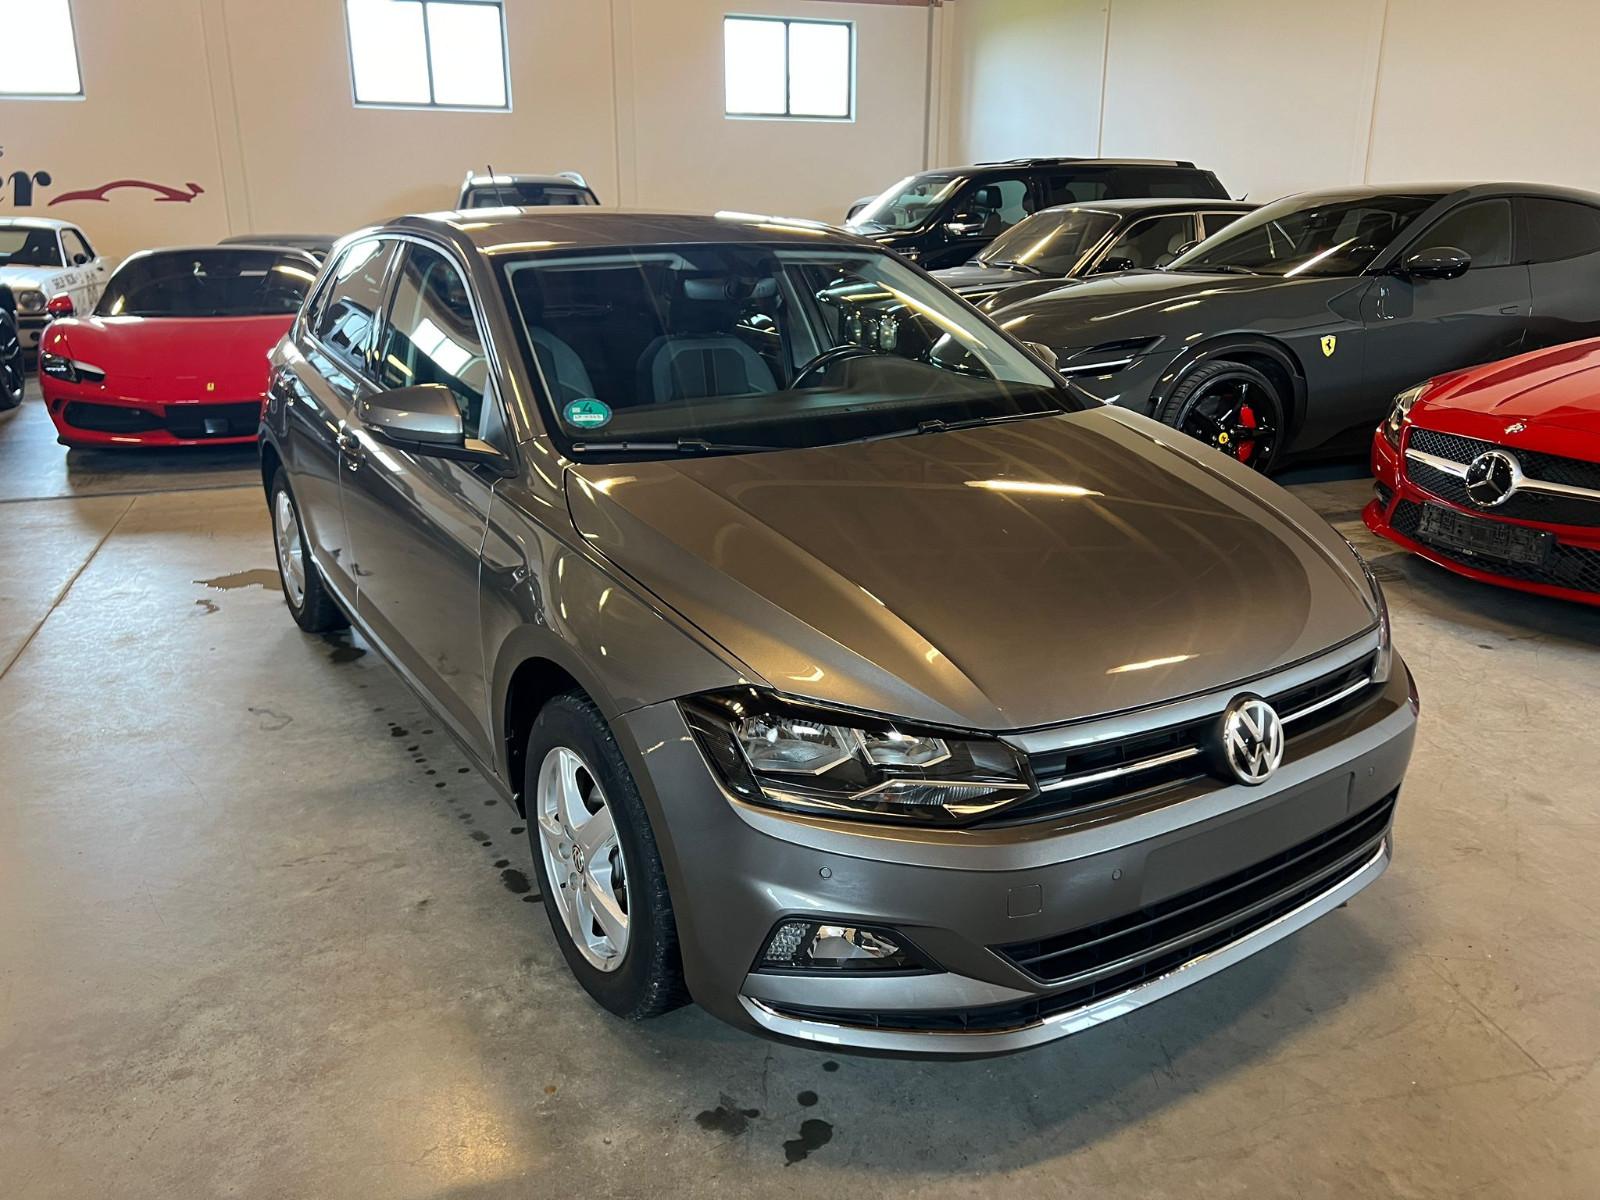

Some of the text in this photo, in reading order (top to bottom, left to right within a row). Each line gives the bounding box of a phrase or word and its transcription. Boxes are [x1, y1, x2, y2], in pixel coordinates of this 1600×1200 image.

[0, 171, 52, 206] r
[581, 402, 593, 413] 4
[1227, 701, 1283, 782] VW
